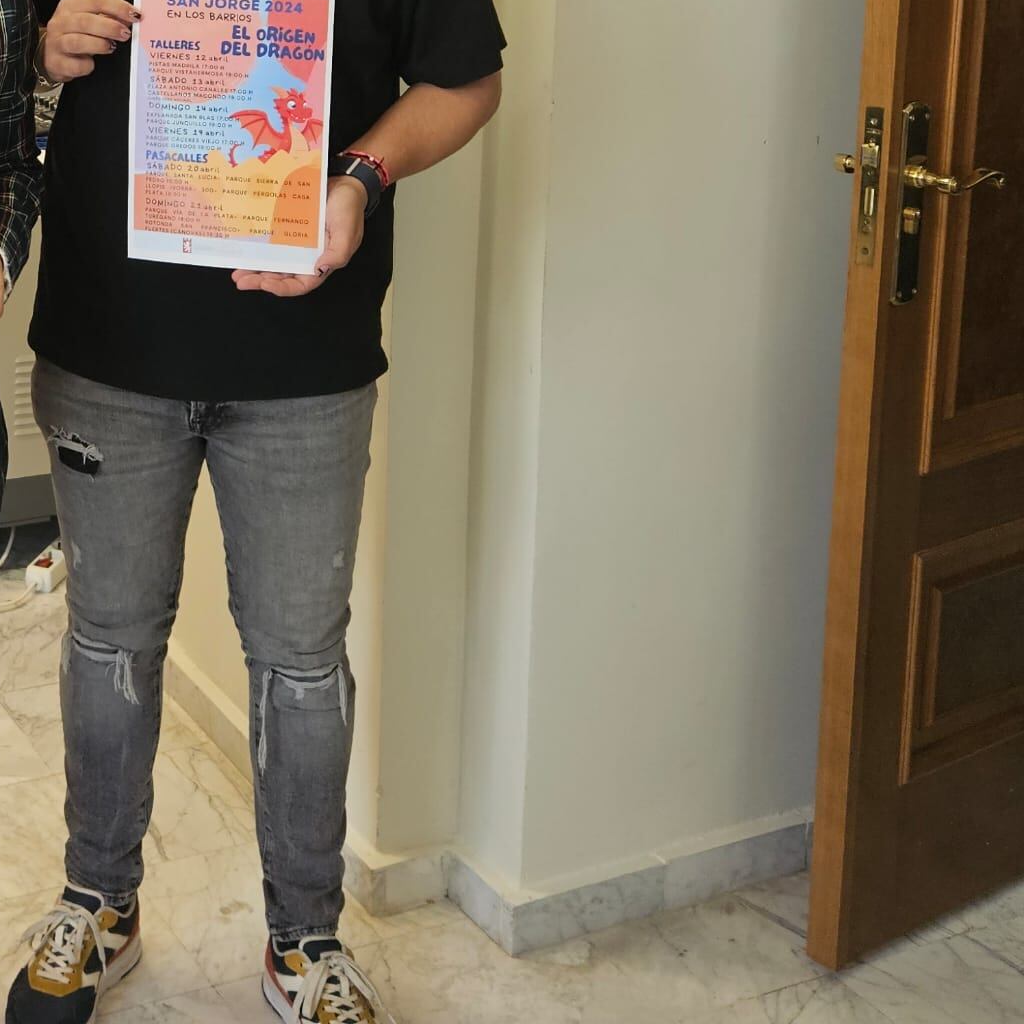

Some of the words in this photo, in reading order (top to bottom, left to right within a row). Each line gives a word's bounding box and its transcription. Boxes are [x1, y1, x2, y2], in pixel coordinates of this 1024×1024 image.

[265, 0, 303, 14] 2024
[167, 10, 182, 18] EN
[185, 11, 205, 20] LOS
[209, 12, 252, 23] BARRIOS
[232, 25, 251, 40] EL
[150, 40, 201, 50] TALLERES
[221, 41, 251, 56] DEL
[256, 42, 325, 61] DRAGÓN
[150, 52, 191, 61] VIERNES
[205, 78, 225, 86] abril
[208, 105, 228, 113] abril
[148, 126, 188, 135] VIERNES
[205, 129, 225, 137] abril
[145, 150, 208, 163] PASACALLES
